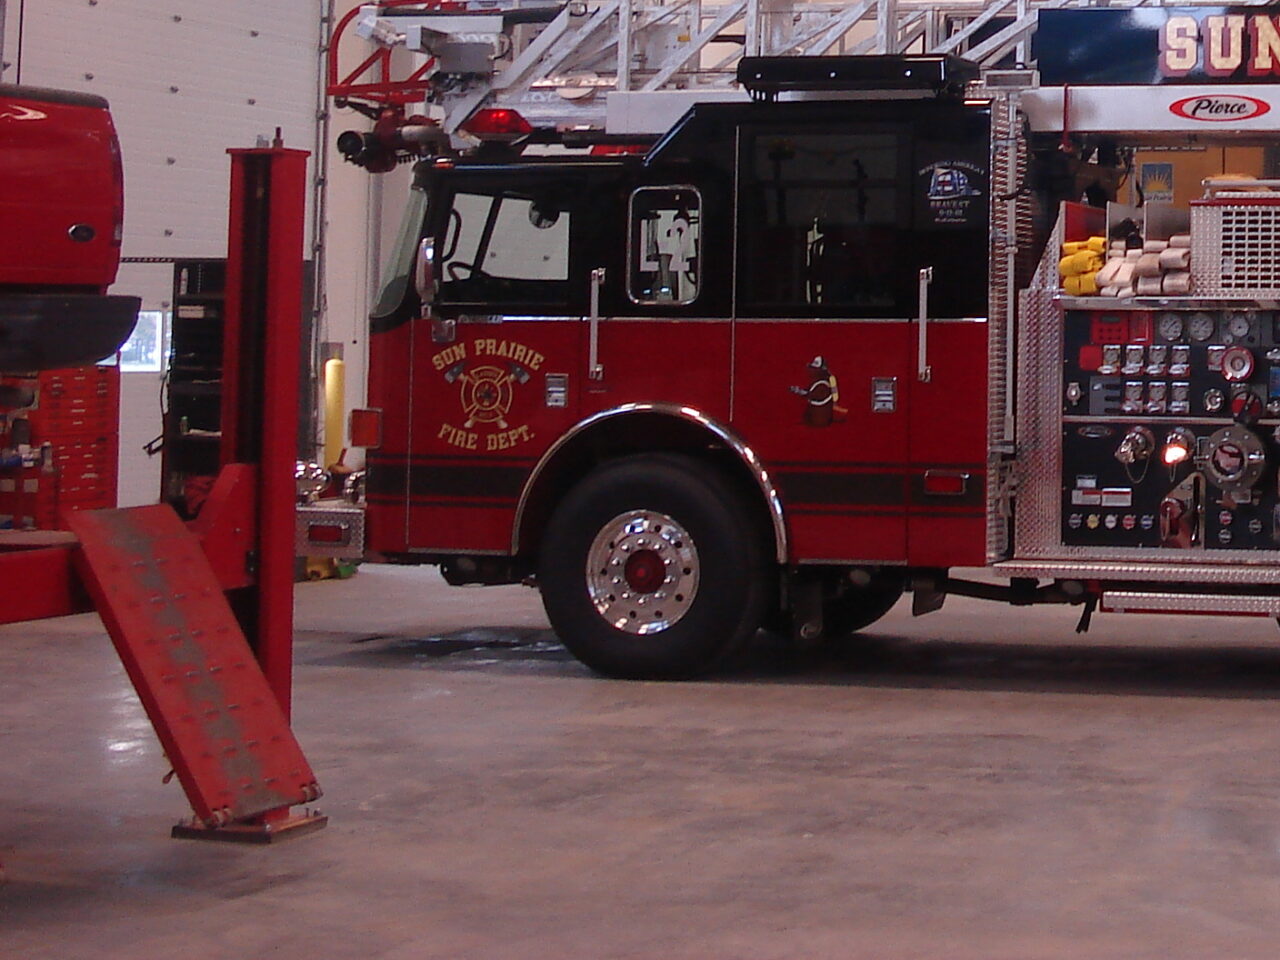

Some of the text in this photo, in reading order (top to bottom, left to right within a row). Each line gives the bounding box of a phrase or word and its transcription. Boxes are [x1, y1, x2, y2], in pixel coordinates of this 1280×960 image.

[1191, 98, 1248, 116] Pierce
[432, 338, 545, 371] SUN PRAIRIE
[438, 423, 536, 451] FIRE DEPT.
